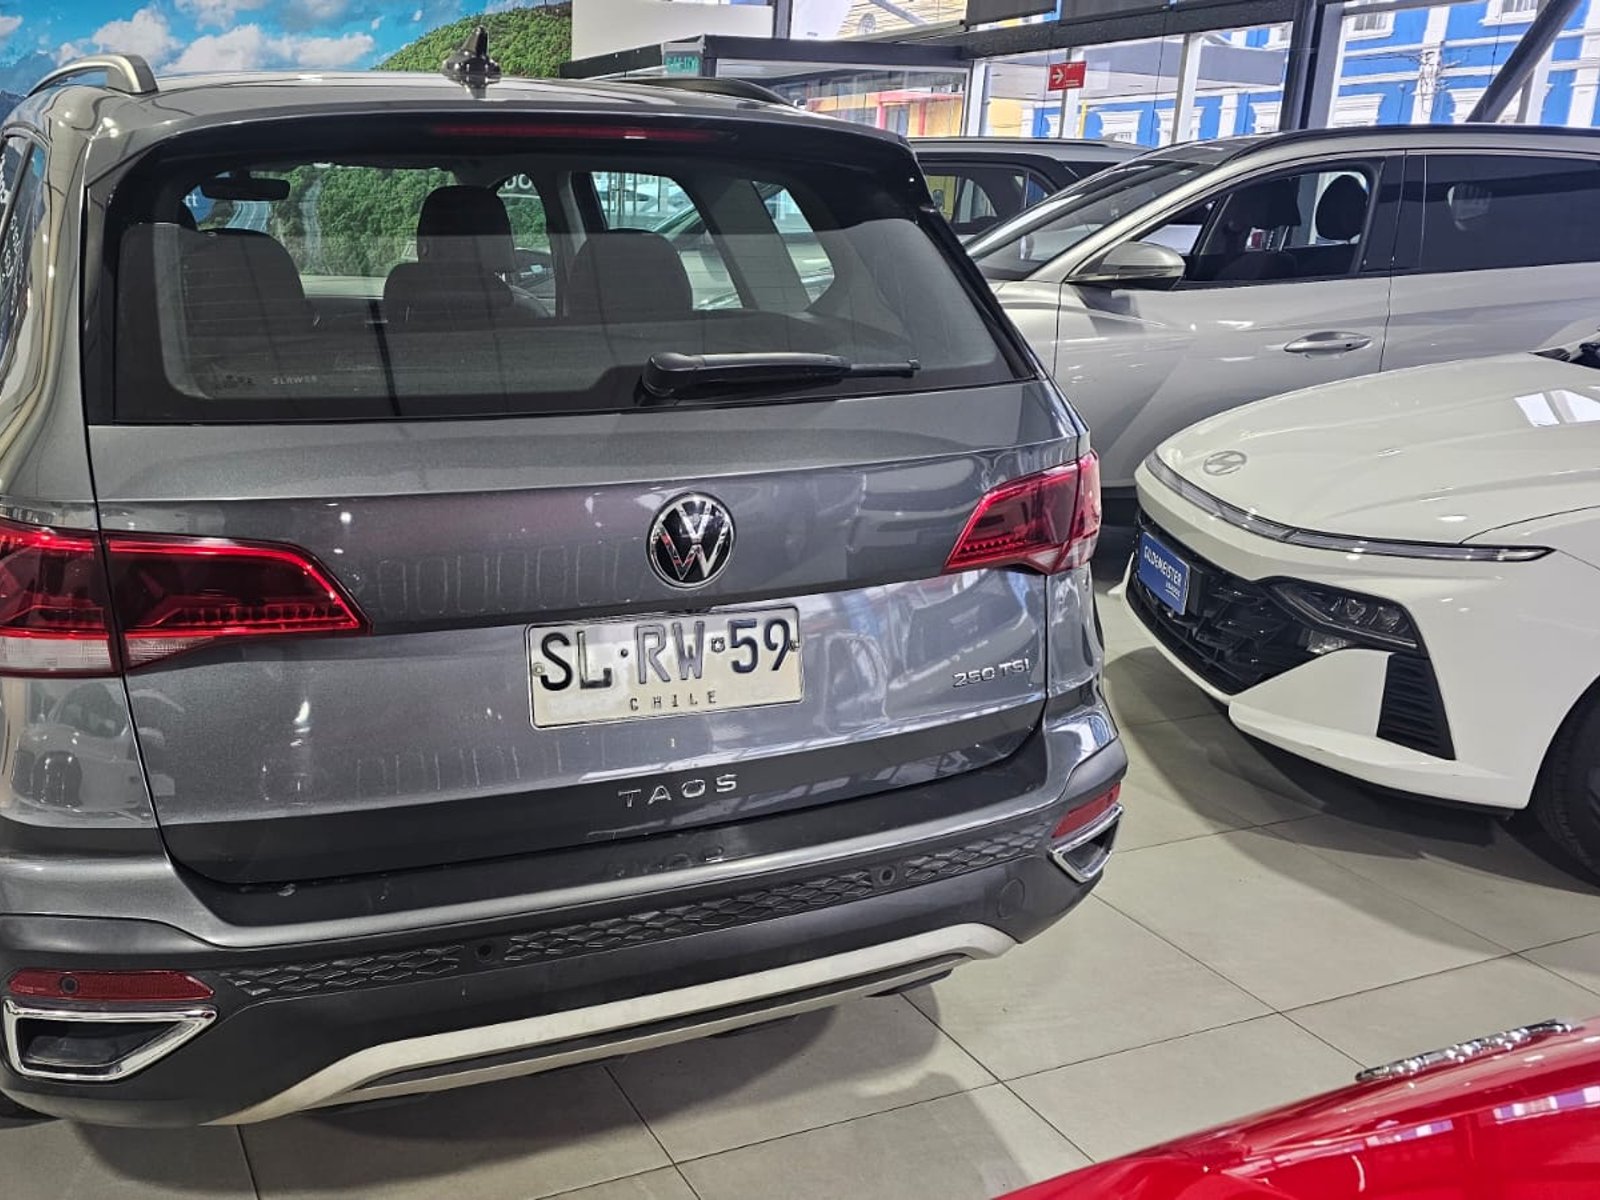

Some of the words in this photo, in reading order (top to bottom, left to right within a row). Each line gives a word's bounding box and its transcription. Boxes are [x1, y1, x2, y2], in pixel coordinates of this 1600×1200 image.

[953, 667, 995, 688] 250
[998, 658, 1030, 677] TSI
[629, 690, 718, 712] CHILE
[617, 773, 738, 808] TAOS
